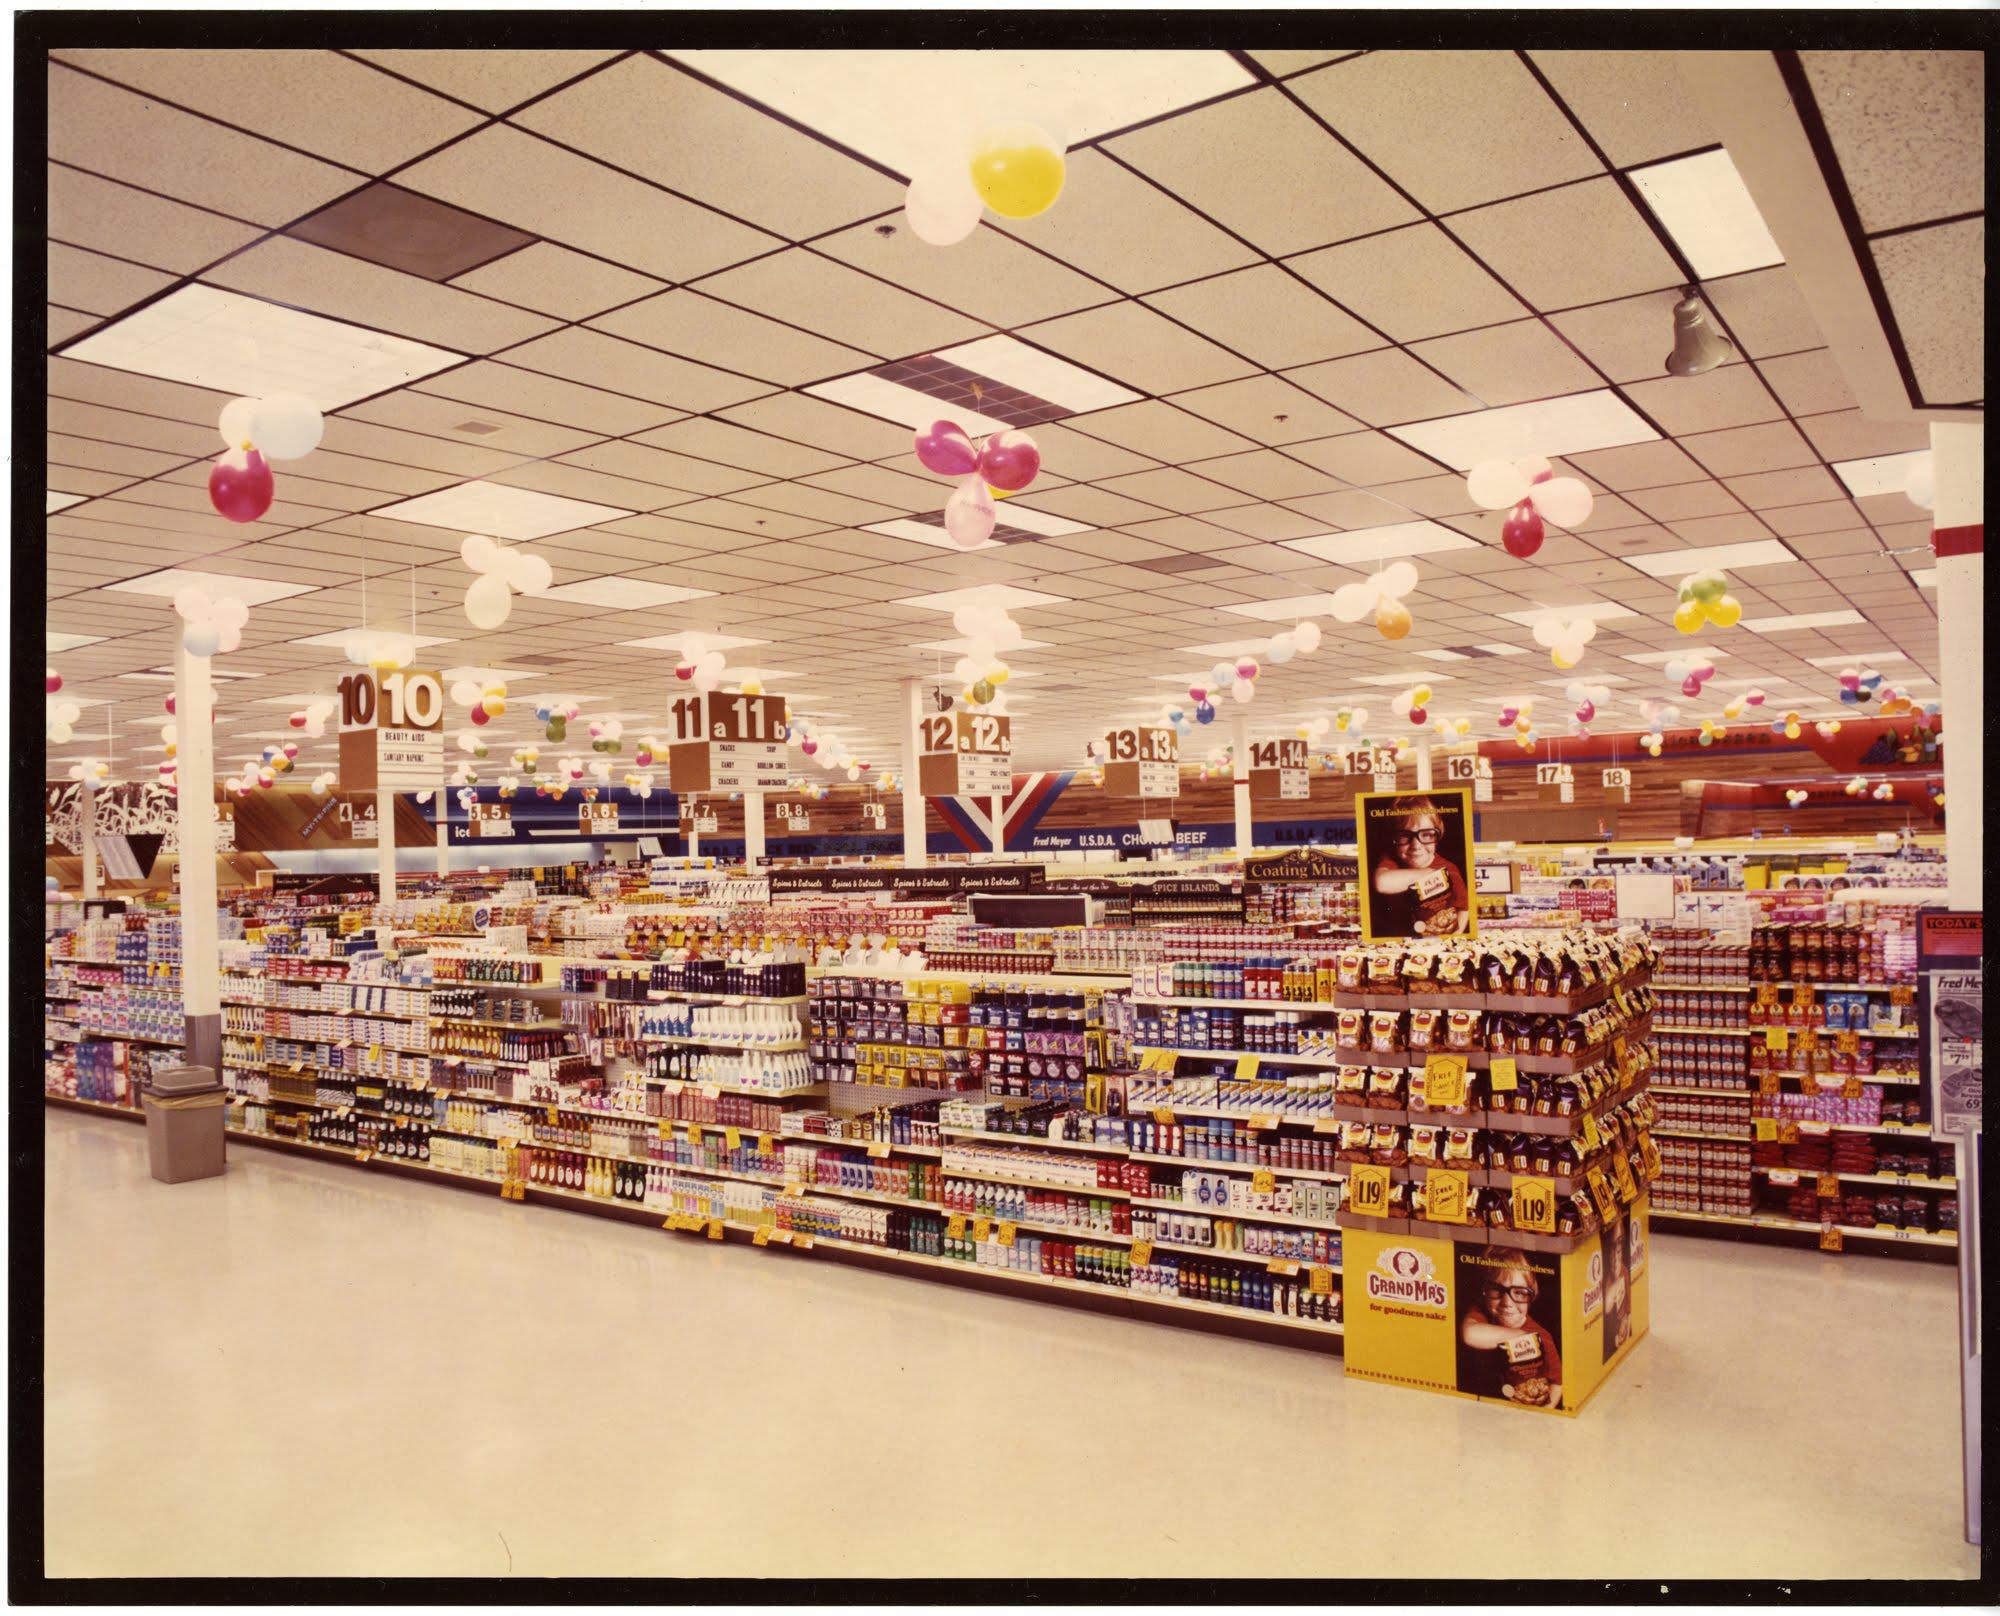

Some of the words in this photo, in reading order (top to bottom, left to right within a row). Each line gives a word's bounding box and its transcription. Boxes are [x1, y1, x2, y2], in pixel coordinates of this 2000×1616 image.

[337, 673, 375, 725] 10
[382, 673, 442, 727] 10
[671, 697, 701, 739] 11
[713, 722, 726, 737] a
[731, 697, 765, 739] 11
[773, 720, 786, 739] b
[385, 732, 408, 741] BEAUTY
[411, 733, 425, 742] AIDS
[920, 716, 953, 751] 12
[971, 716, 1000, 751] 12
[1105, 730, 1137, 759] 13
[1150, 730, 1171, 760] 13
[1249, 742, 1278, 767] 14
[1287, 742, 1303, 767] 14
[1346, 752, 1372, 773] 15
[1450, 759, 1473, 777] 16
[1540, 766, 1558, 782] 17
[1605, 771, 1623, 785] 18
[363, 804, 377, 820] 4
[471, 805, 478, 819] 5
[491, 804, 502, 819] 5
[581, 804, 589, 818] 6
[601, 803, 610, 818] 6
[684, 804, 691, 817] 7
[703, 804, 710, 817] 7
[780, 804, 786, 817] 8
[795, 803, 802, 817] 8
[866, 805, 873, 816] 9
[878, 803, 885, 816] 9
[1370, 809, 1385, 818] Old
[1033, 837, 1049, 846] Fred
[1050, 837, 1072, 847] Meyer
[1079, 835, 1116, 846] U.S.D.A.
[1176, 832, 1207, 844] BEEF
[1251, 864, 1308, 878] Coating
[1312, 863, 1357, 876] Mixes
[773, 878, 791, 888] Spices
[798, 878, 822, 888] Extracts
[831, 878, 852, 889] Spices
[858, 878, 884, 888] Extracts
[893, 877, 915, 888] Spices
[922, 878, 949, 888] Extracts
[960, 877, 983, 889] Spices
[990, 876, 1020, 887] Extracts
[1152, 883, 1177, 892] SPICE
[1181, 883, 1220, 892] ISLANDS
[1938, 976, 1963, 989] Fred
[1460, 1254, 1475, 1264] Old
[1370, 1303, 1383, 1311] for
[1383, 1306, 1424, 1318] goodness
[1425, 1312, 1447, 1320] sake
